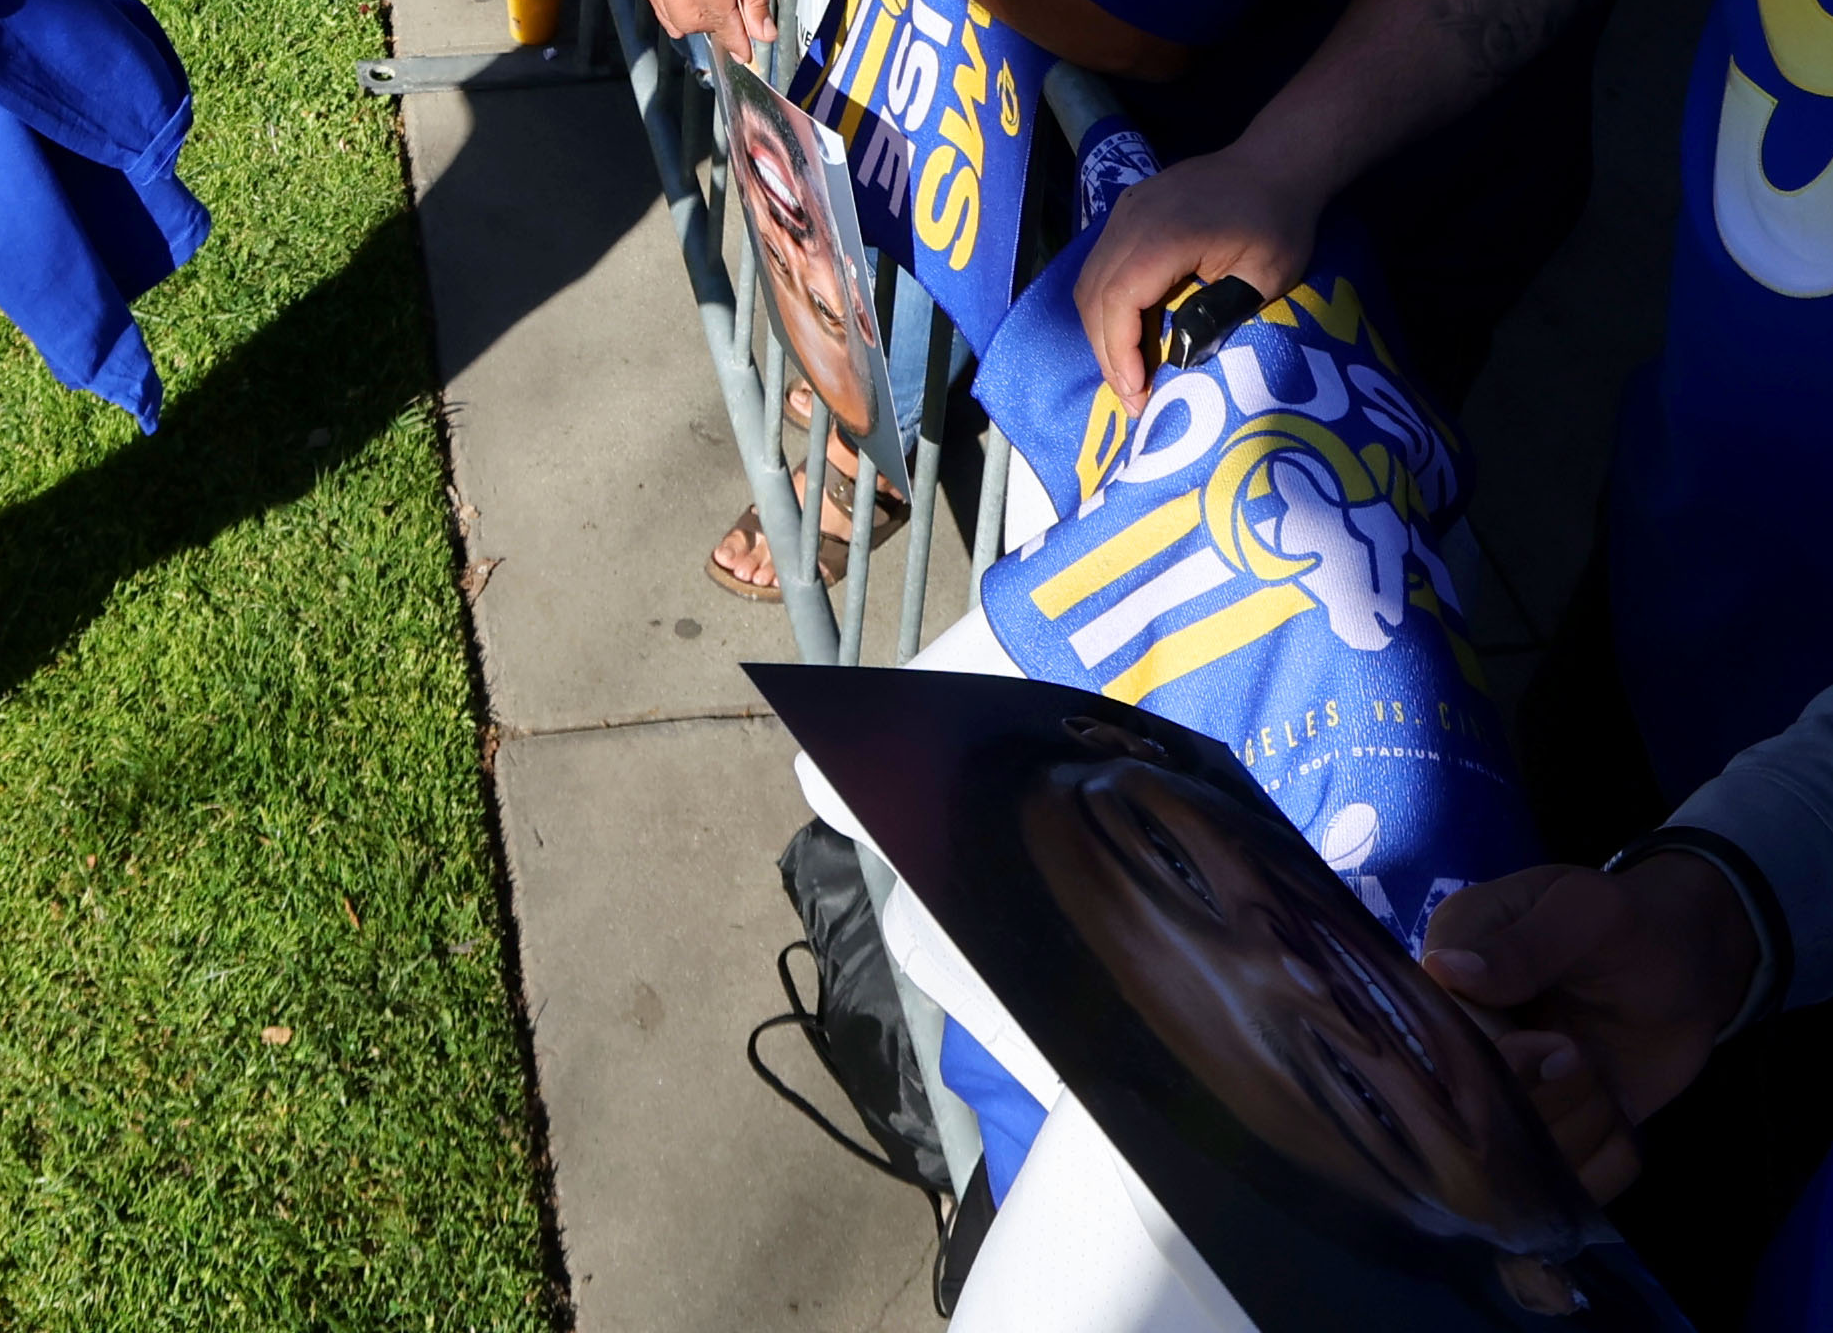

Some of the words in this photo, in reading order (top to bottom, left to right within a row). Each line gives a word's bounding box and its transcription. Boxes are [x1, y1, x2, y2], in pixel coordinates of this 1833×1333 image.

[1243, 699, 1340, 770] GELES
[1373, 700, 1423, 725] VS.
[1298, 750, 1341, 776] SOFI
[1351, 745, 1441, 763] STADIUM
